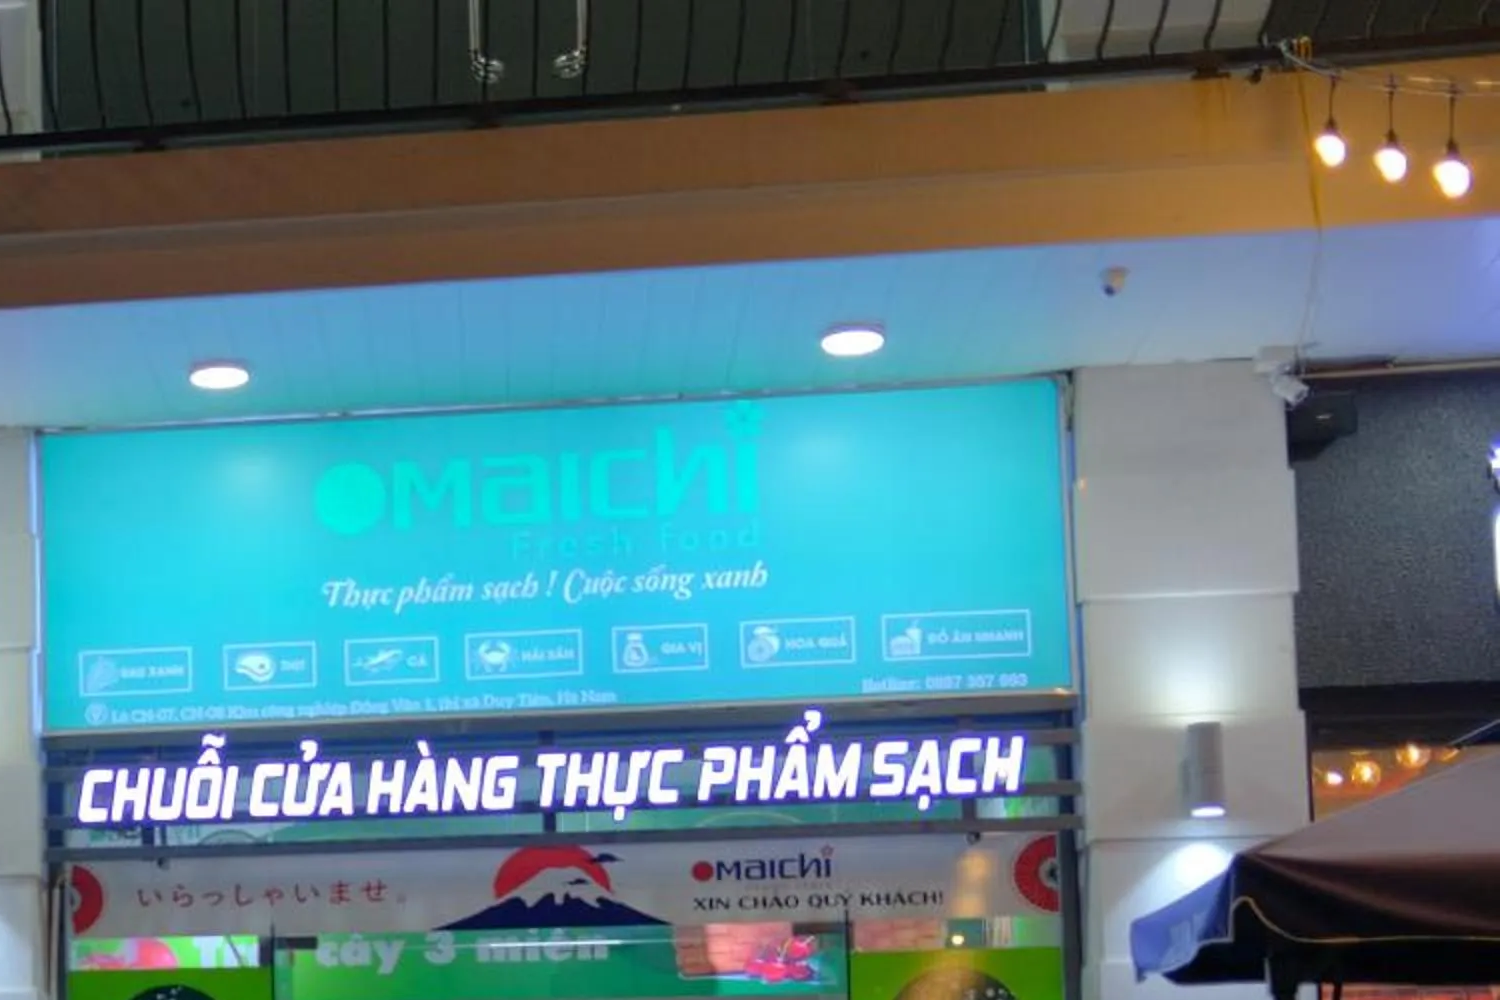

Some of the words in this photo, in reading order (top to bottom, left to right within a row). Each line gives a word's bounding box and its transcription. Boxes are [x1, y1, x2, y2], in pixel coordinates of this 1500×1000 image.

[512, 524, 632, 561] Fresh
[661, 519, 760, 552] food
[323, 575, 393, 609] Thực
[395, 572, 473, 615] phẩm
[562, 566, 627, 605] Cuộc
[630, 563, 694, 599] sống
[701, 559, 769, 590] xanh
[76, 734, 238, 825] CHUỖI
[248, 738, 355, 819] CỬA
[365, 735, 519, 816] HÀNG
[534, 746, 681, 821] THỰC
[697, 708, 860, 803] PHẨM
[868, 735, 1026, 810] SẠCH
[715, 845, 834, 882] Maichi
[693, 897, 731, 912] XIN
[424, 930, 457, 965] 3
